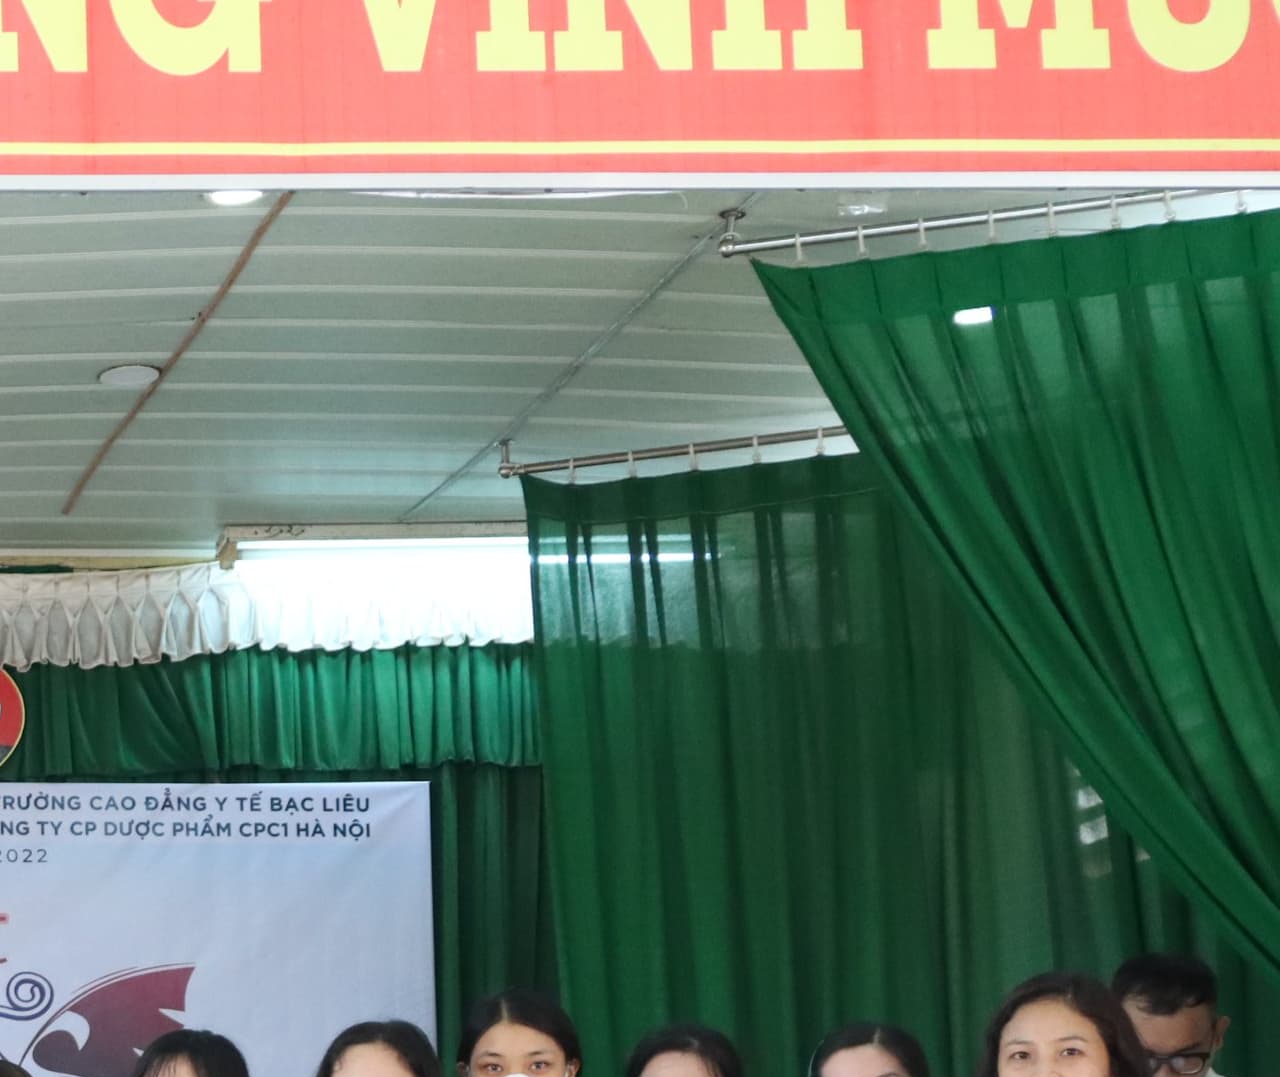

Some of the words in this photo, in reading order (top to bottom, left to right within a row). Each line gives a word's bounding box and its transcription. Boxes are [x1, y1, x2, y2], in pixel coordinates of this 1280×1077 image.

[89, 796, 136, 811] CAO
[144, 788, 207, 812] ĐẲNG
[215, 797, 228, 812] Y
[236, 791, 263, 812] TẾ
[270, 797, 314, 816] BẠC
[322, 793, 370, 812] LIÊU
[37, 821, 63, 836] TY
[70, 821, 97, 836] CP
[104, 820, 165, 840] DƯỢC
[172, 814, 231, 837] PHẨM
[239, 822, 289, 837] CPC1
[296, 818, 325, 837] HÀ
[333, 819, 370, 841] NỘI
